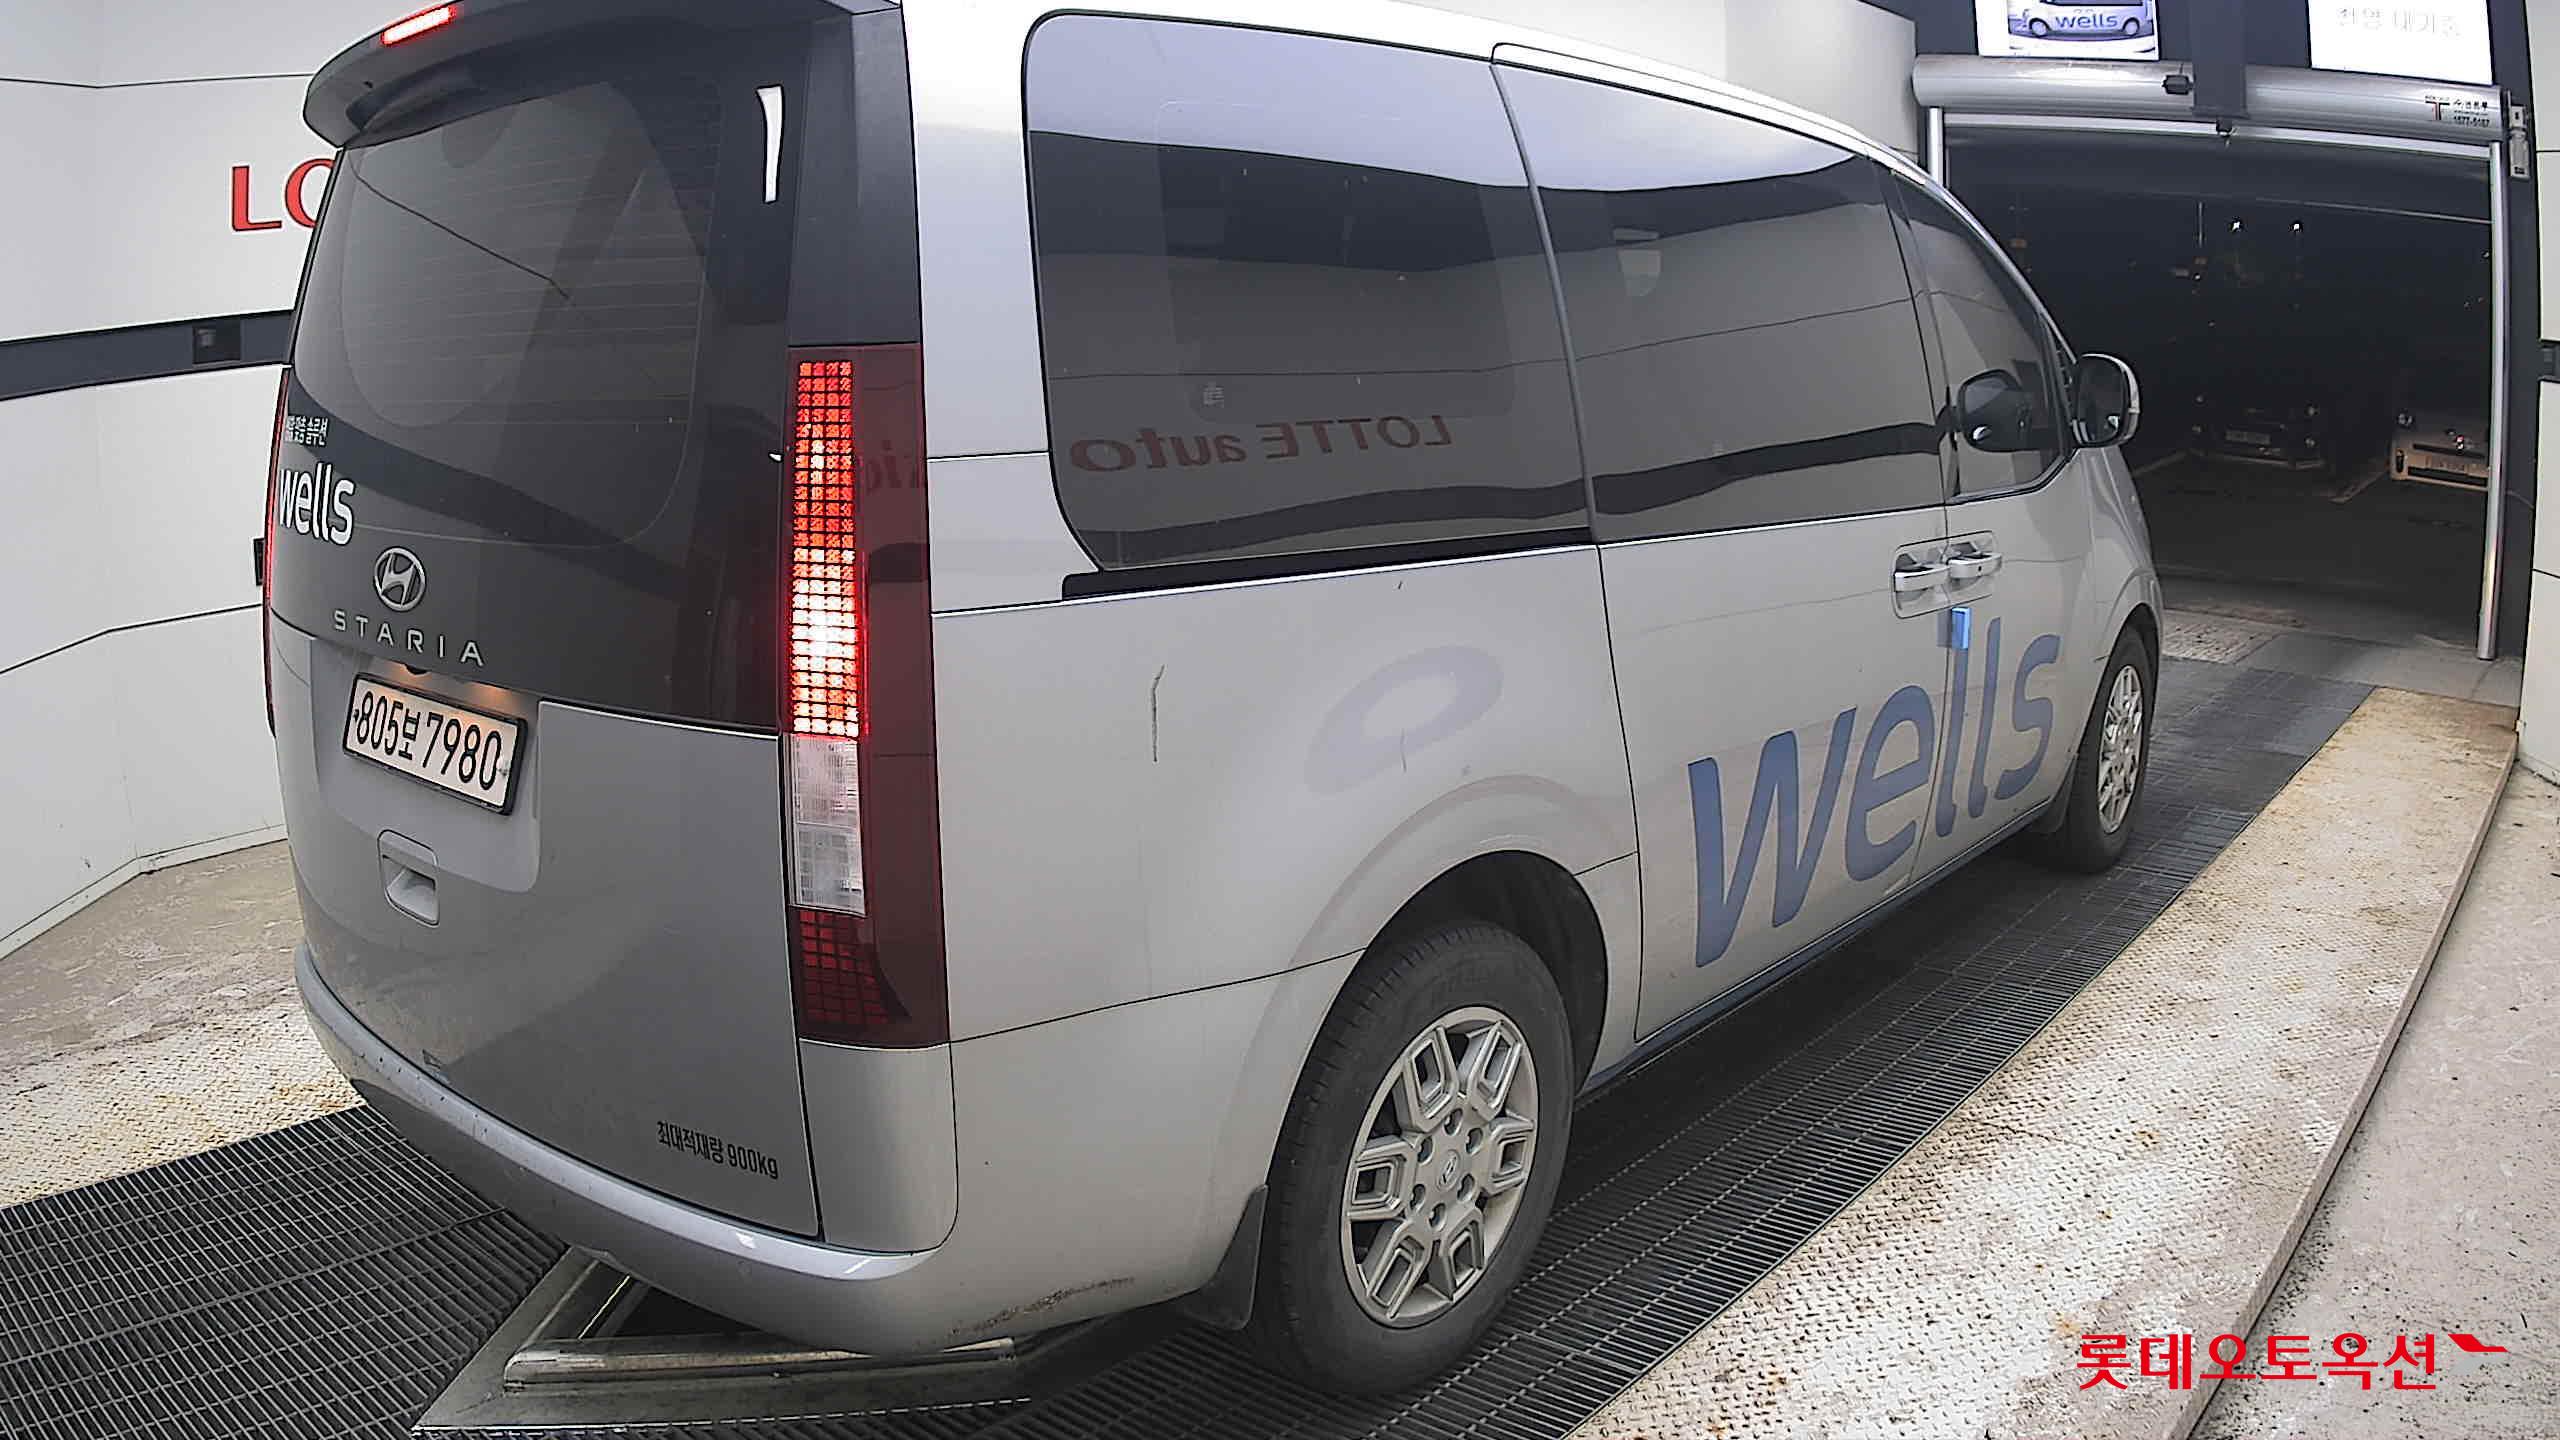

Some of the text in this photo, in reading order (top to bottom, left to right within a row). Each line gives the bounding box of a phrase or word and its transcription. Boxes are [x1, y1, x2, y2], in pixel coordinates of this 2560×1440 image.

[2055, 14, 2118, 28] wells
[279, 462, 355, 546] wells
[332, 610, 484, 668] STARIA
[424, 710, 502, 791] 7980
[1687, 616, 2062, 969] wells
[657, 1120, 779, 1181] 최대적재량 900kg
